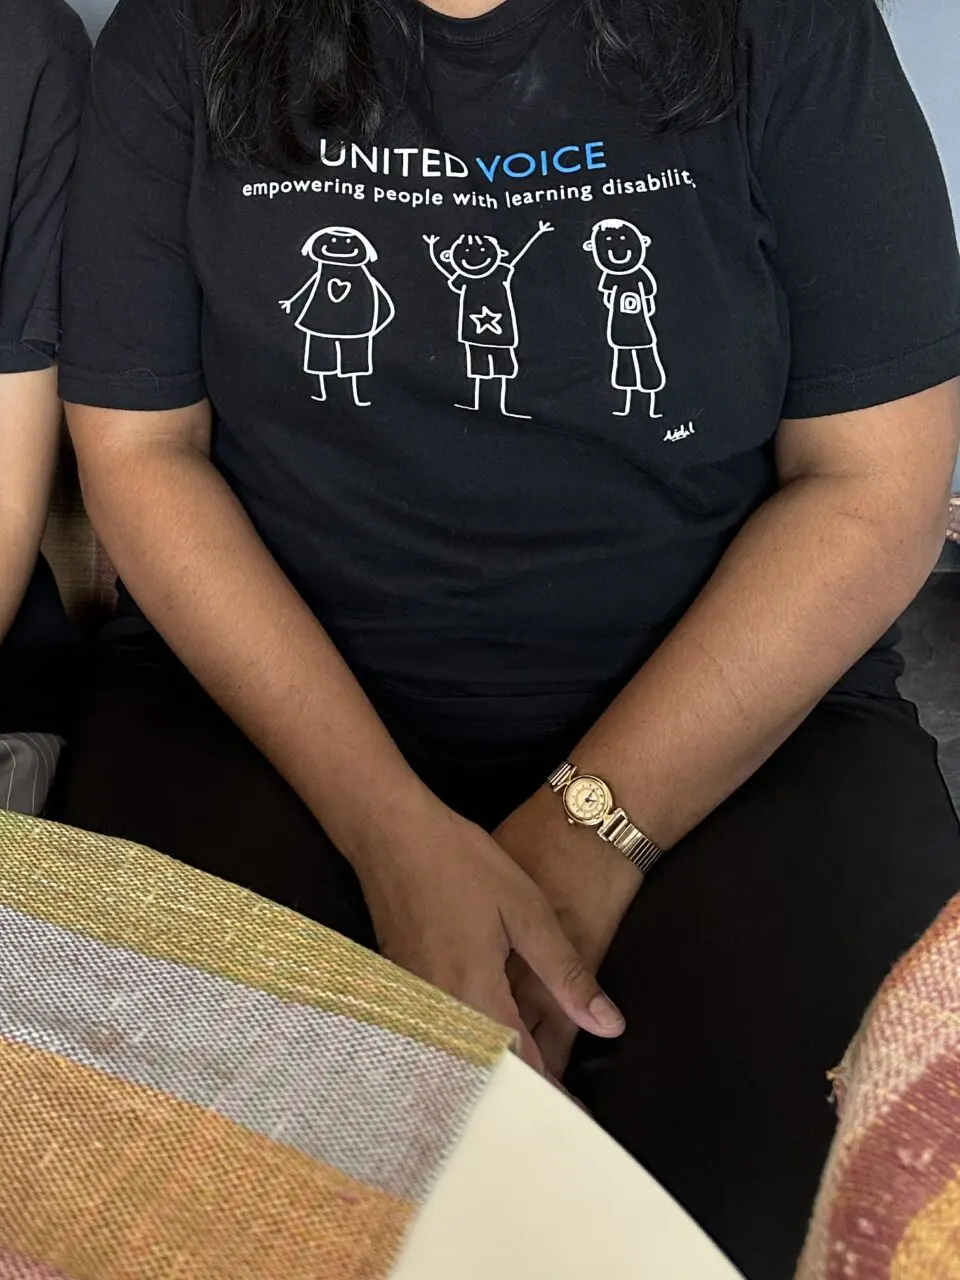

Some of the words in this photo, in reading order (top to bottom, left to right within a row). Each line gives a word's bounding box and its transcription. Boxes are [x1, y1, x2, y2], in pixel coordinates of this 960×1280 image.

[320, 138, 469, 177] UNITED
[475, 141, 607, 183] VOICE
[242, 178, 365, 200] empowering
[373, 188, 444, 208] people
[452, 190, 498, 209] with
[505, 184, 593, 209] learning
